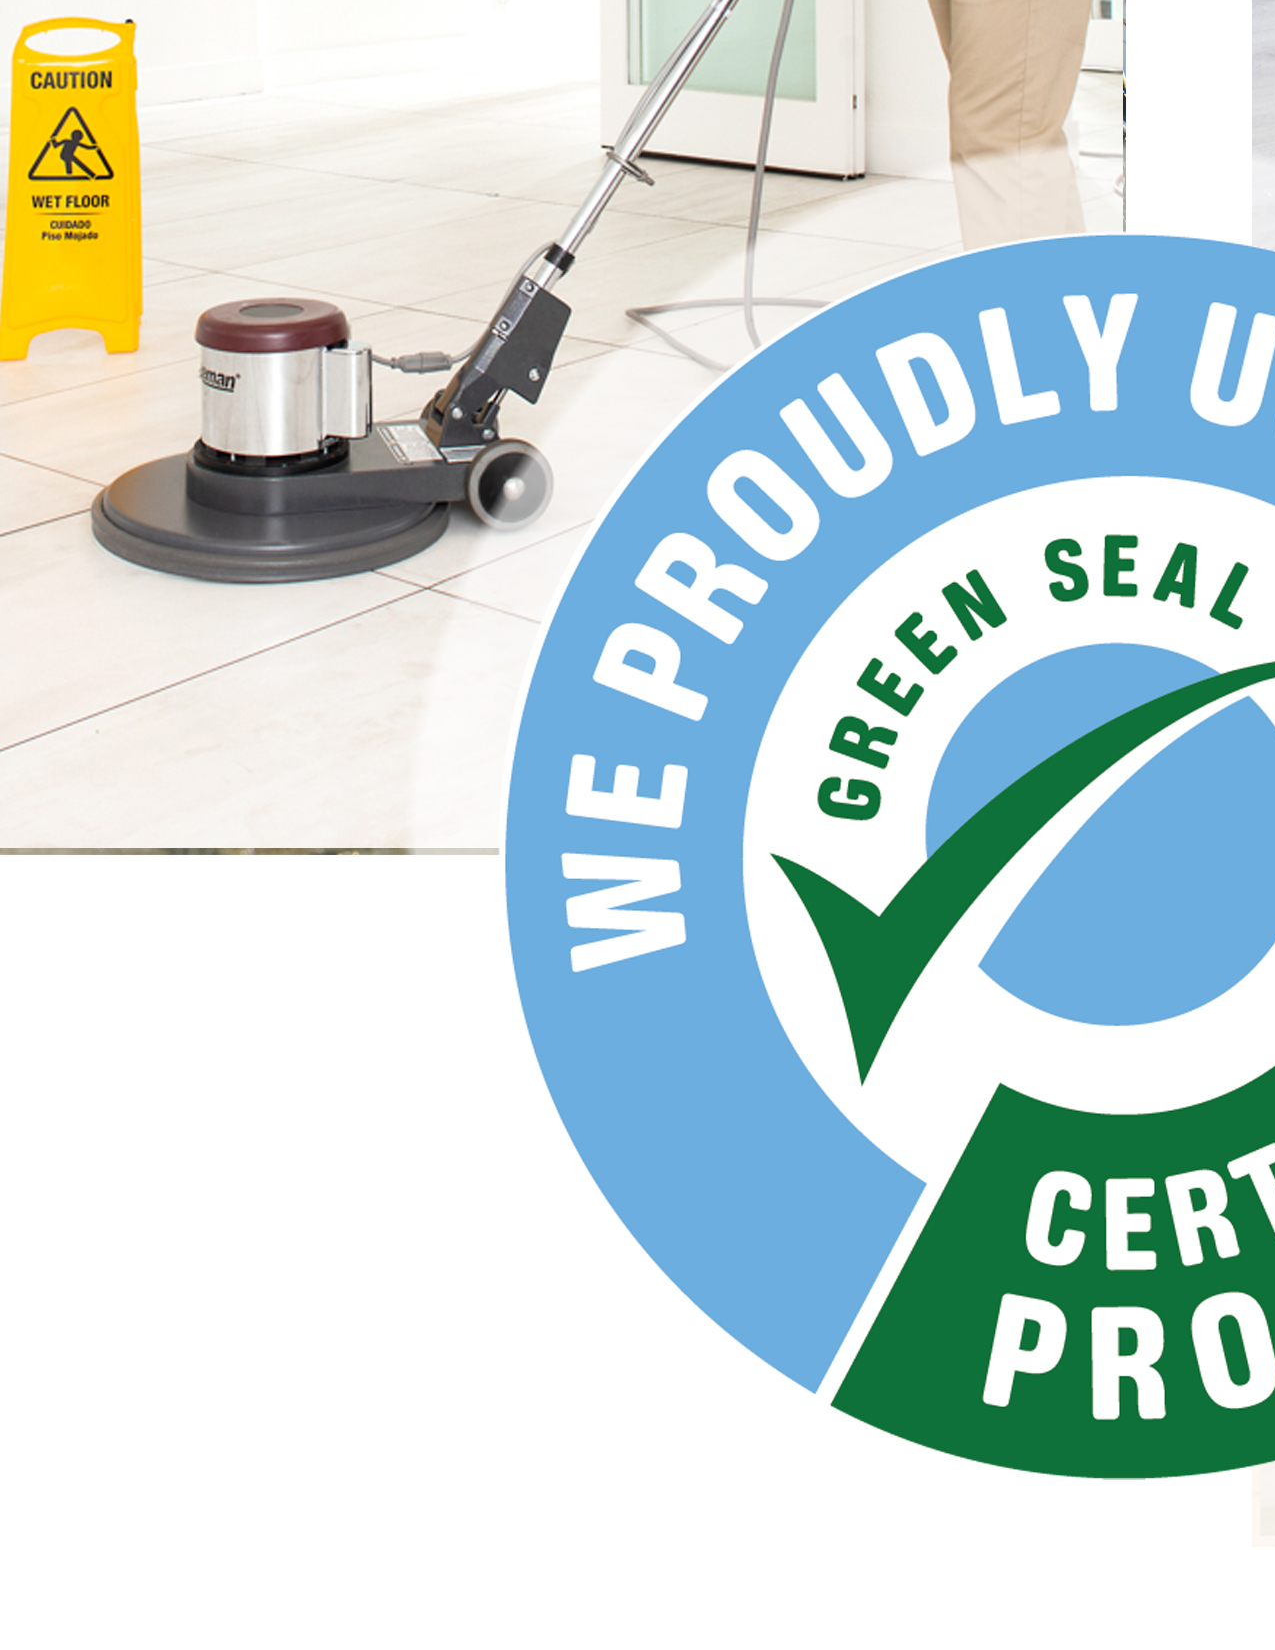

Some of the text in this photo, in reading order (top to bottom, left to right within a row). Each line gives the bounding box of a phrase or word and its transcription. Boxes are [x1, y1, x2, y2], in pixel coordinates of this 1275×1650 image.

[30, 70, 112, 90] CAUTION
[31, 194, 110, 208] WET FLOOR
[49, 220, 91, 229] CUIDADO
[41, 231, 98, 241] Piso Mojado
